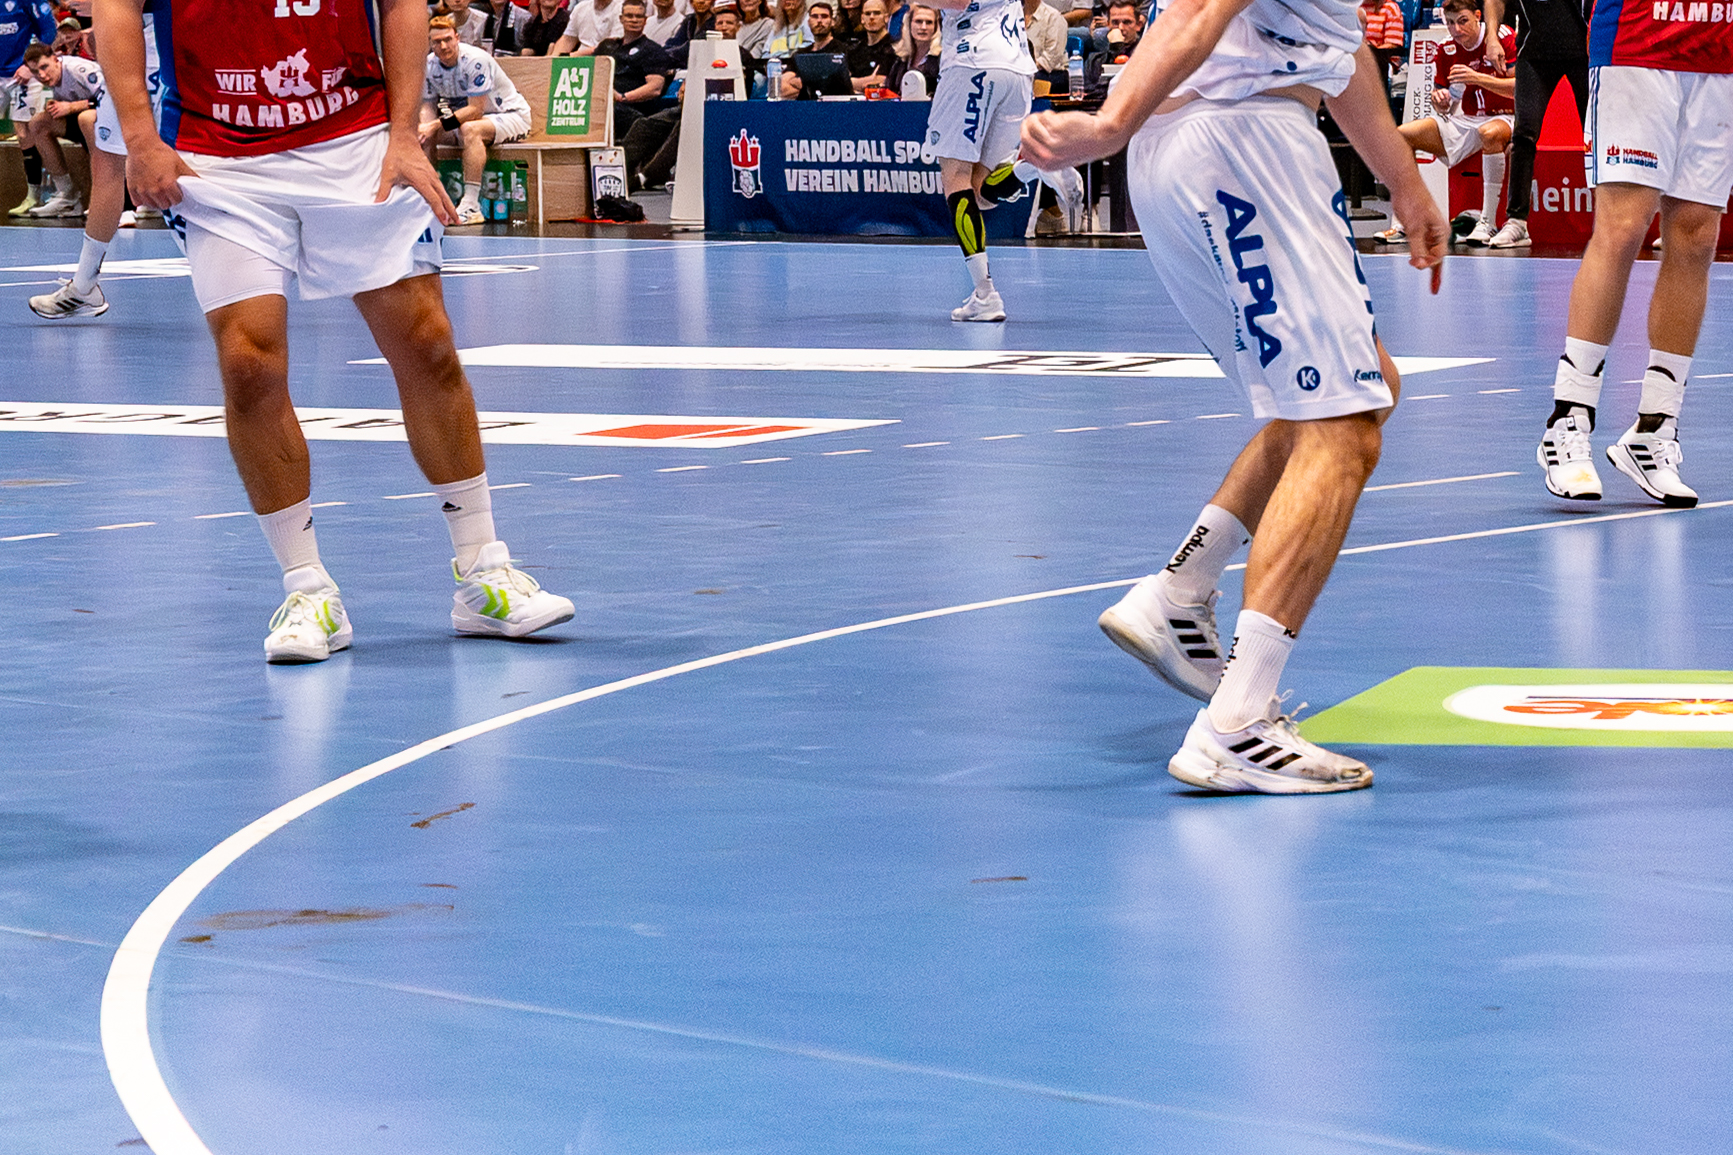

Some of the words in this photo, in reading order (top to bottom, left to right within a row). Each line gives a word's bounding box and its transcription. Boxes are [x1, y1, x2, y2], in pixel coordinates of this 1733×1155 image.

[215, 73, 257, 92] WIR
[553, 67, 590, 98] A&J
[1424, 66, 1432, 81] KG
[552, 99, 586, 115] HOLZ
[962, 70, 987, 144] ALPLA
[551, 116, 585, 127] ZENTRUM
[785, 139, 891, 164] HANDBALL
[894, 140, 939, 165] SPO
[785, 169, 859, 193] VEREIN
[1216, 189, 1282, 369] ALPLA
[1165, 525, 1209, 574] Kempa
